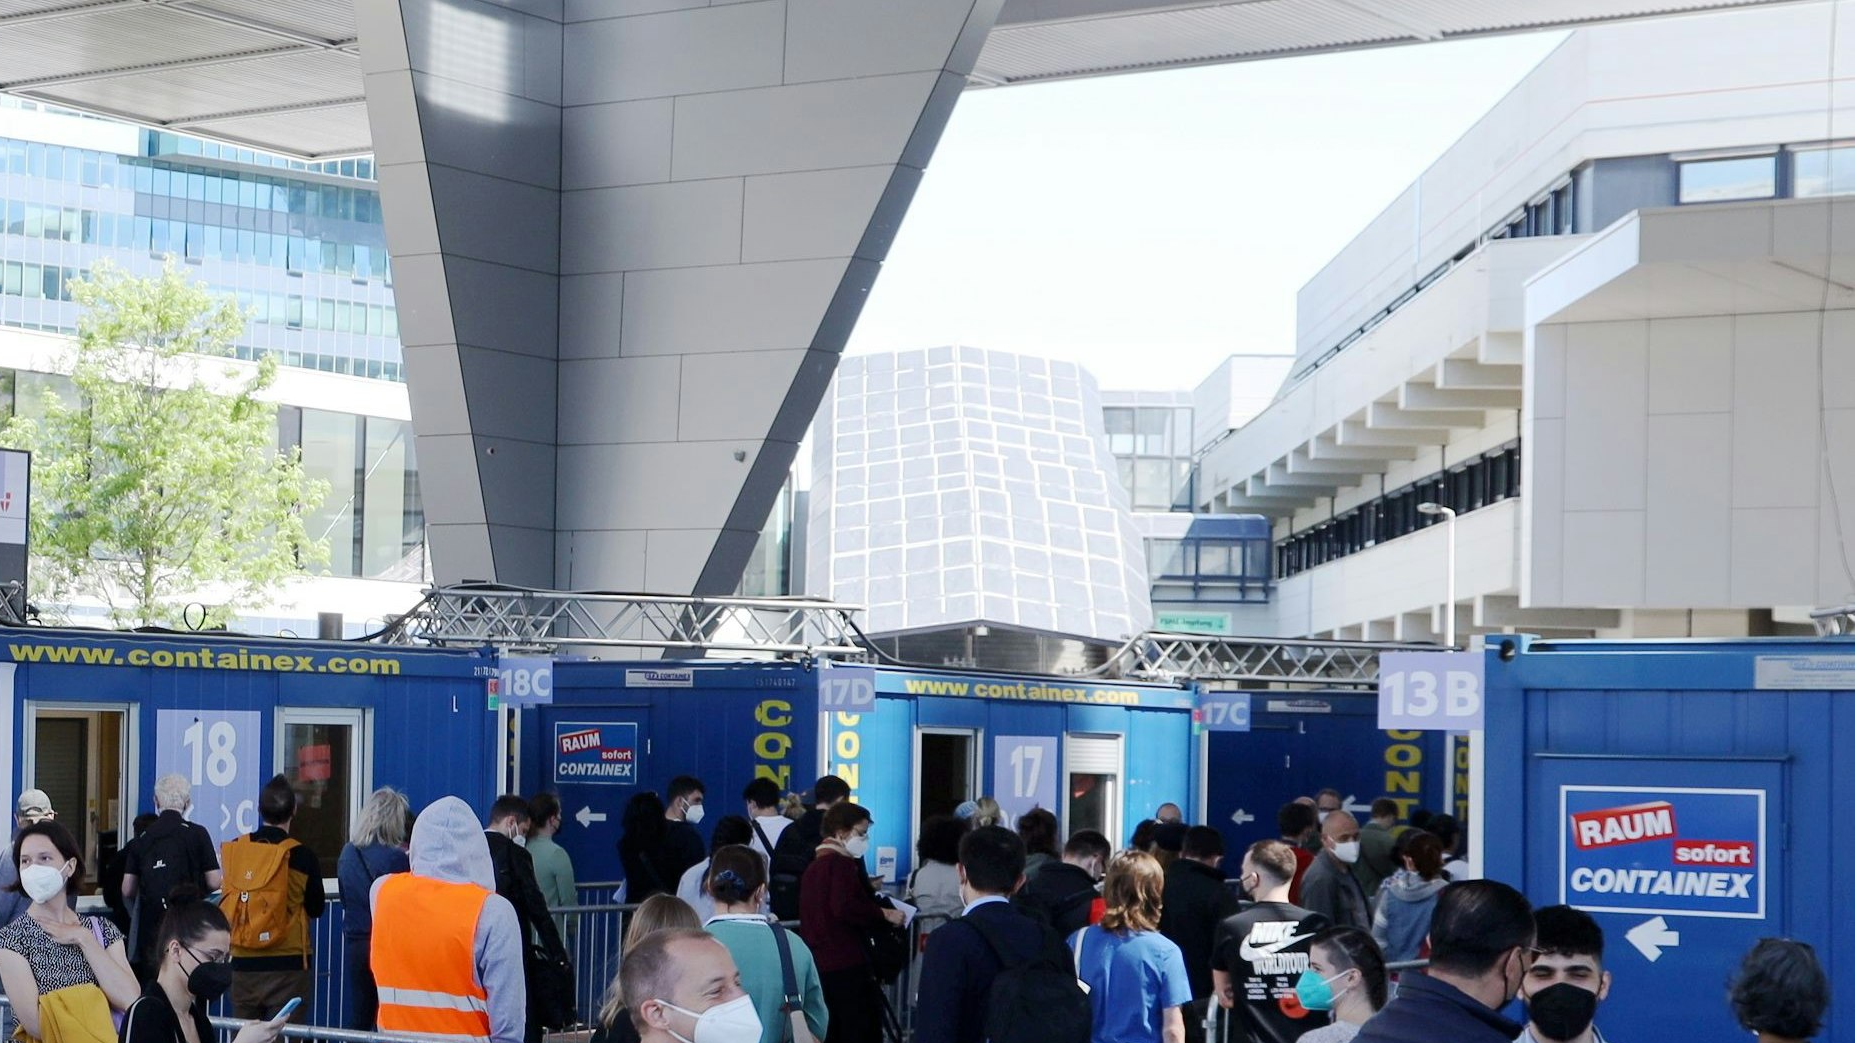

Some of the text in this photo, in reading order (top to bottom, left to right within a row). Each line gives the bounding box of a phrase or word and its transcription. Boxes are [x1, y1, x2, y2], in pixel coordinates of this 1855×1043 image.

[8, 643, 400, 675] www.containex.com
[501, 668, 550, 697] 18C
[820, 678, 875, 705] 17D
[1202, 702, 1246, 725] 17C
[183, 720, 237, 787] 18
[562, 732, 601, 752] RAUM
[602, 749, 632, 760] sofort
[559, 762, 632, 777] CONTAINEX
[1010, 745, 1043, 798] 17
[236, 800, 253, 833] C
[1579, 809, 1673, 846] RAUM
[1675, 843, 1751, 864] sofort
[1571, 866, 1754, 899] CONTAINEX
[1249, 921, 1300, 944] NIKE
